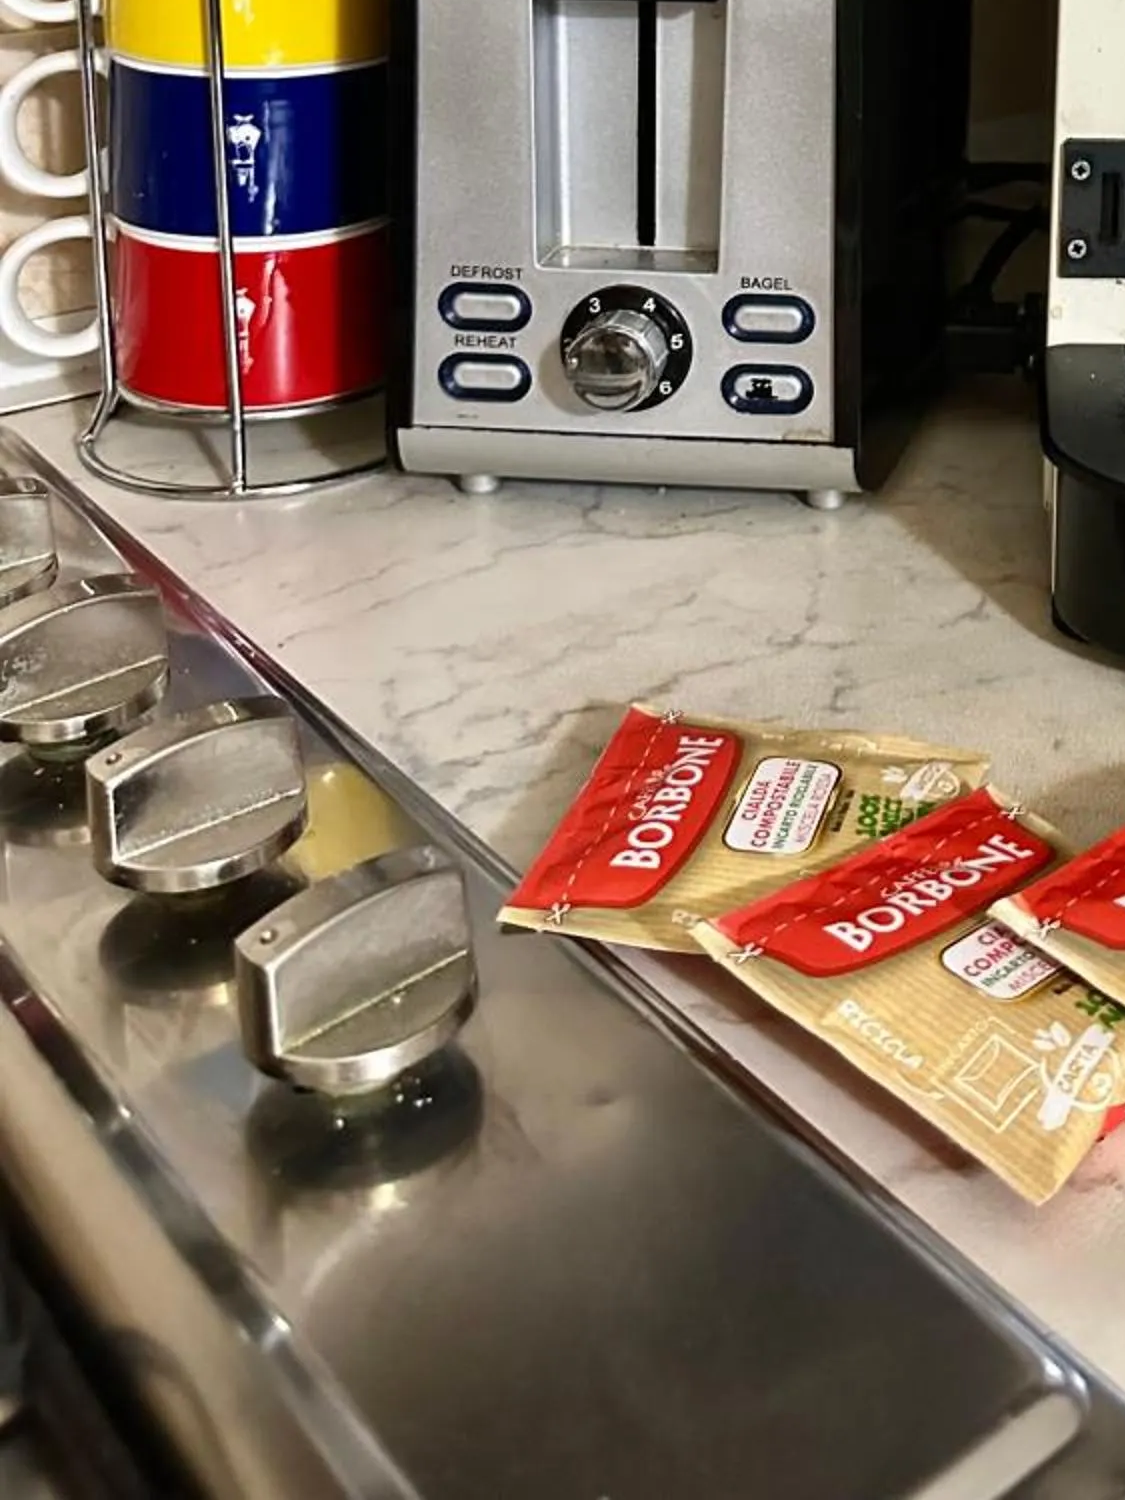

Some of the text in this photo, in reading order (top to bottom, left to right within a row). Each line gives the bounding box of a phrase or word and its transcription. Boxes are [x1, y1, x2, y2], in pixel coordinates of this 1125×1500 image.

[450, 264, 524, 281] DEFROST
[740, 277, 793, 291] BAGEL
[589, 297, 601, 314] 3
[642, 297, 657, 313] 4
[454, 334, 517, 349] REHEAT
[670, 333, 684, 350] 5
[659, 380, 673, 395] 6
[609, 735, 724, 869] BORBONE
[741, 780, 770, 821] CIALDA
[750, 760, 801, 848] COMPOSTABILE
[771, 809, 797, 848] INCARTO
[822, 834, 1035, 952] BORBONE
[837, 1000, 924, 1069] RICICLA
[1058, 1043, 1098, 1094] CARTA
